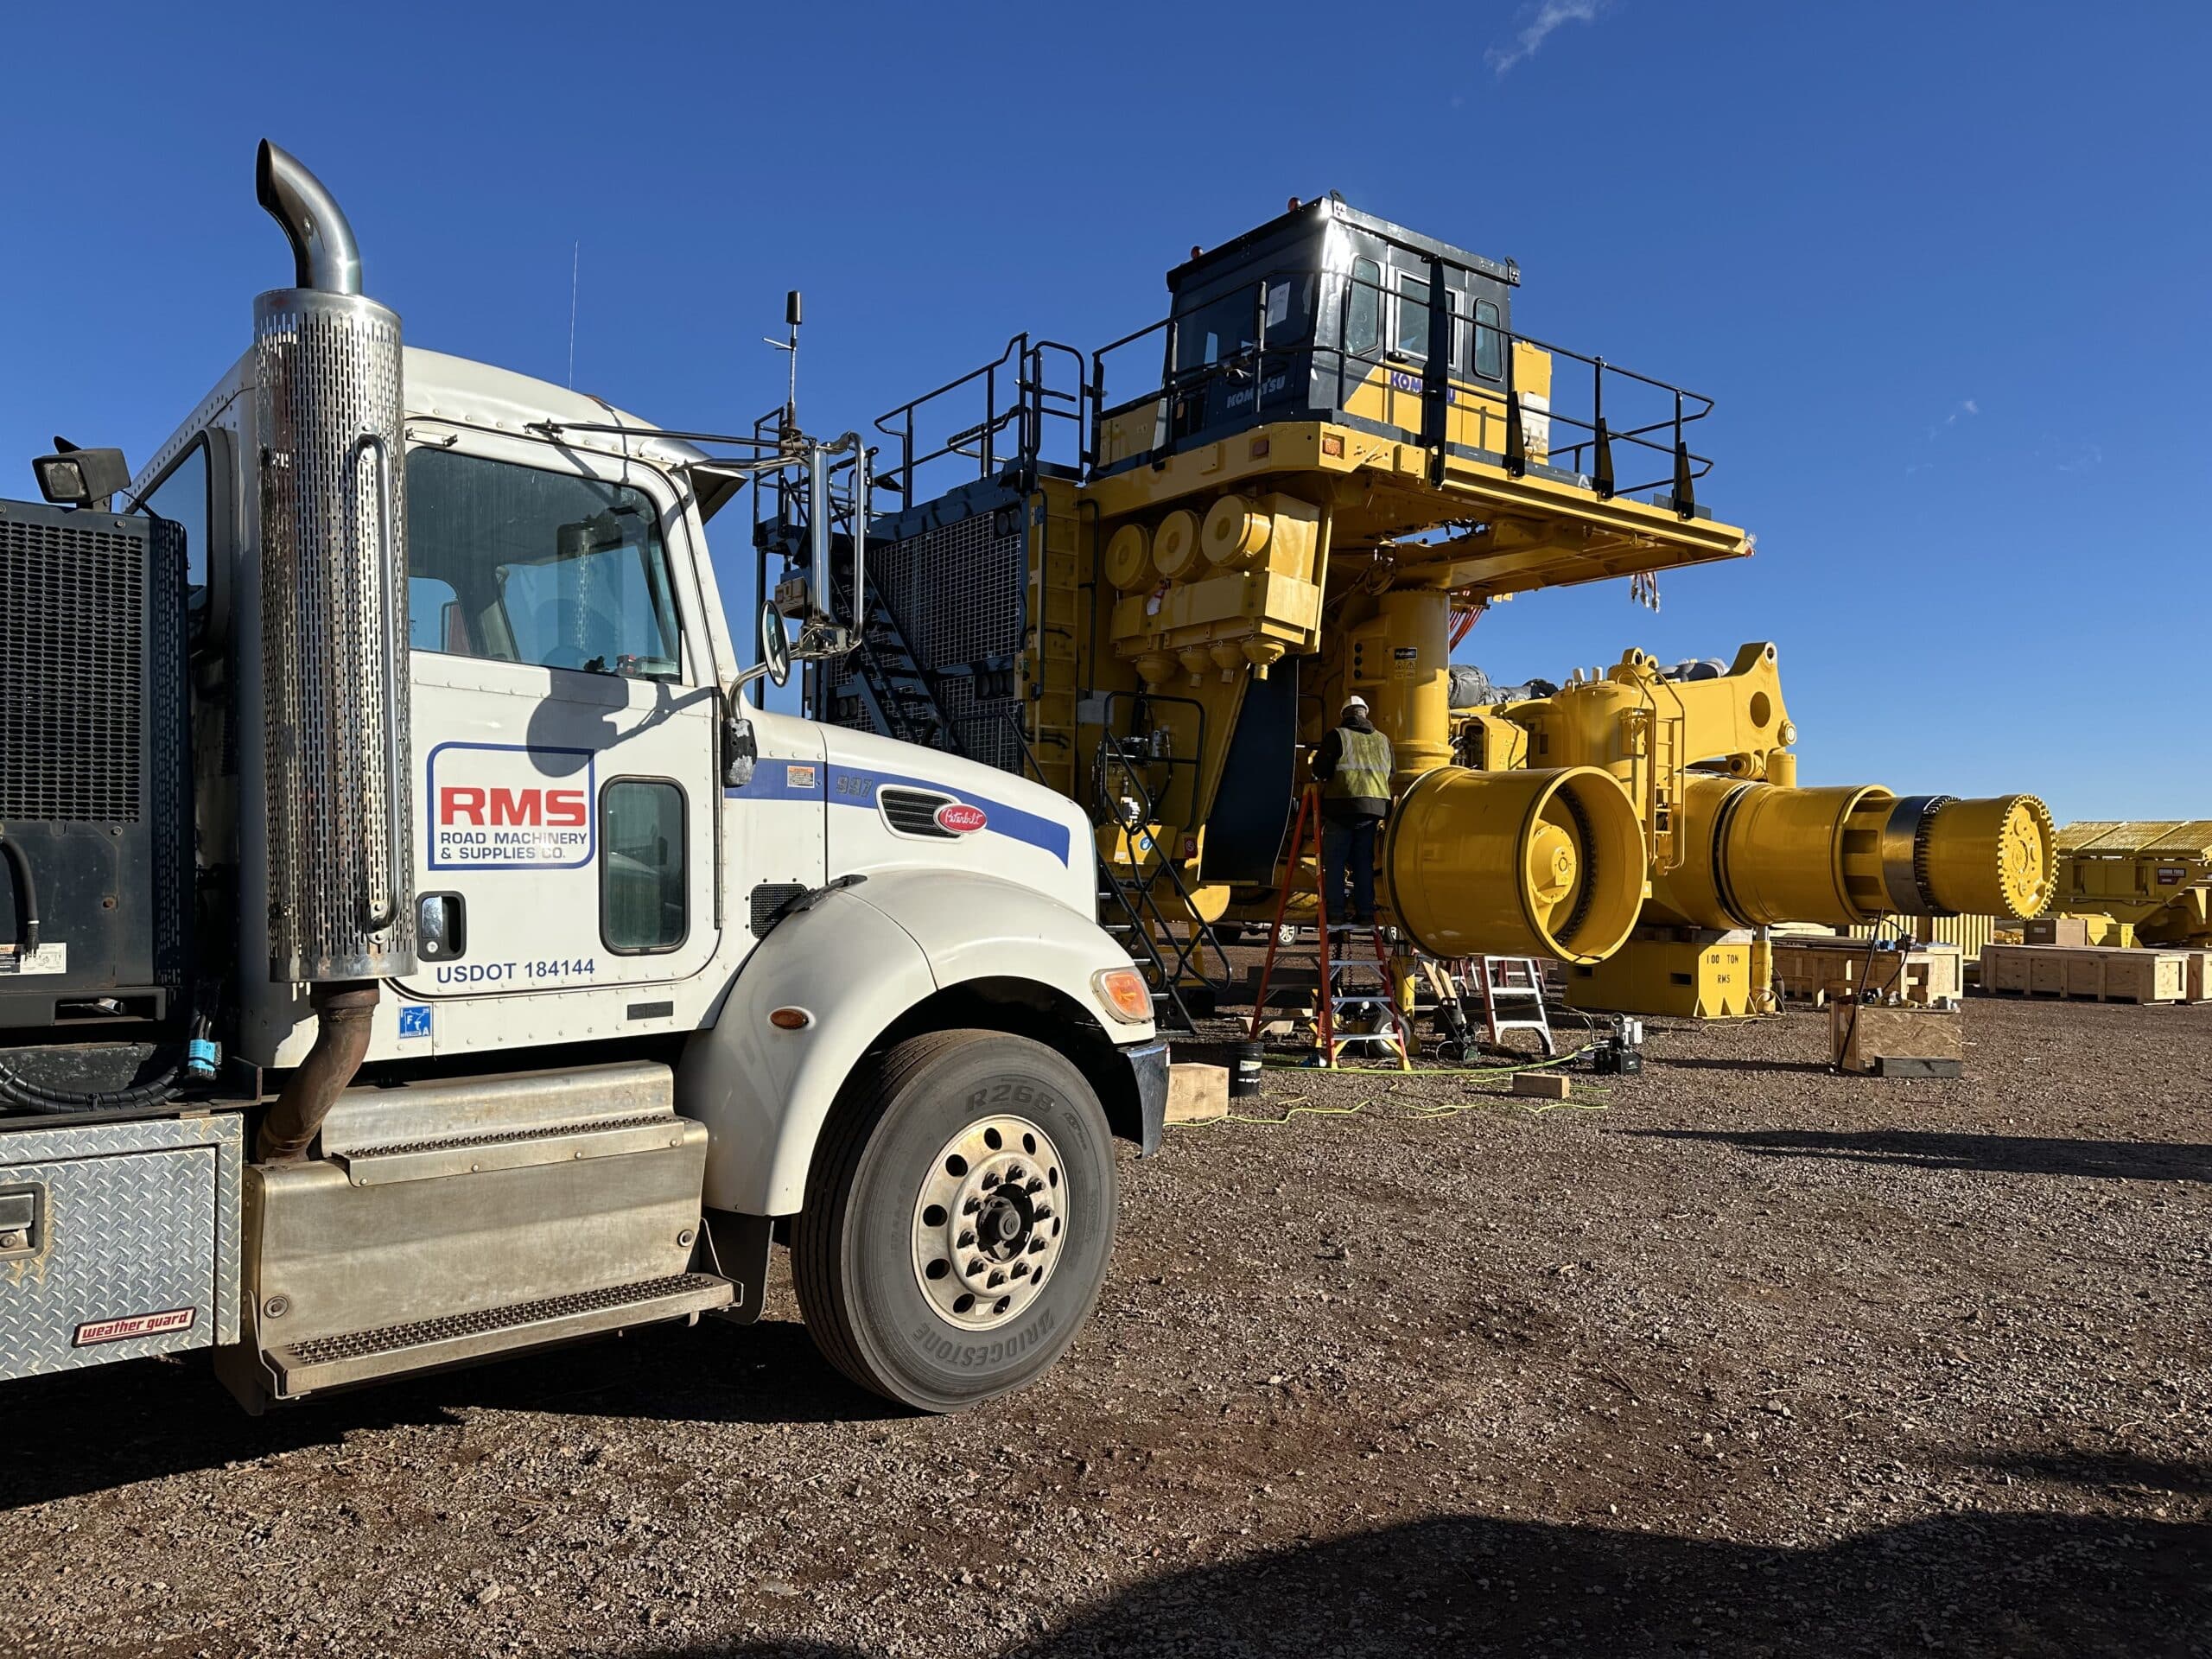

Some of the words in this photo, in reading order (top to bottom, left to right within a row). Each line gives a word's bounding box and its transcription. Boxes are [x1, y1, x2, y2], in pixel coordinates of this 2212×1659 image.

[1227, 375, 1286, 409] KOMTSU
[1390, 371, 1456, 404] KOMU
[836, 775, 874, 798] 997
[441, 787, 586, 827] RMS
[944, 809, 983, 825] Peterbilt
[441, 832, 486, 844] ROAD
[494, 832, 588, 845] MACHINERY
[441, 848, 452, 859] &
[460, 848, 536, 859] SUPPLIES
[542, 847, 566, 859] CO.
[437, 963, 517, 984] USDOT
[524, 958, 595, 978] 184144
[1707, 954, 1719, 964] 100
[1726, 954, 1739, 964] TON
[1717, 974, 1731, 984] RMS
[965, 1084, 1055, 1114] R268
[82, 1319, 144, 1339] weather
[146, 1312, 188, 1331] guard
[912, 1307, 1056, 1367] BRIDGESTONE
